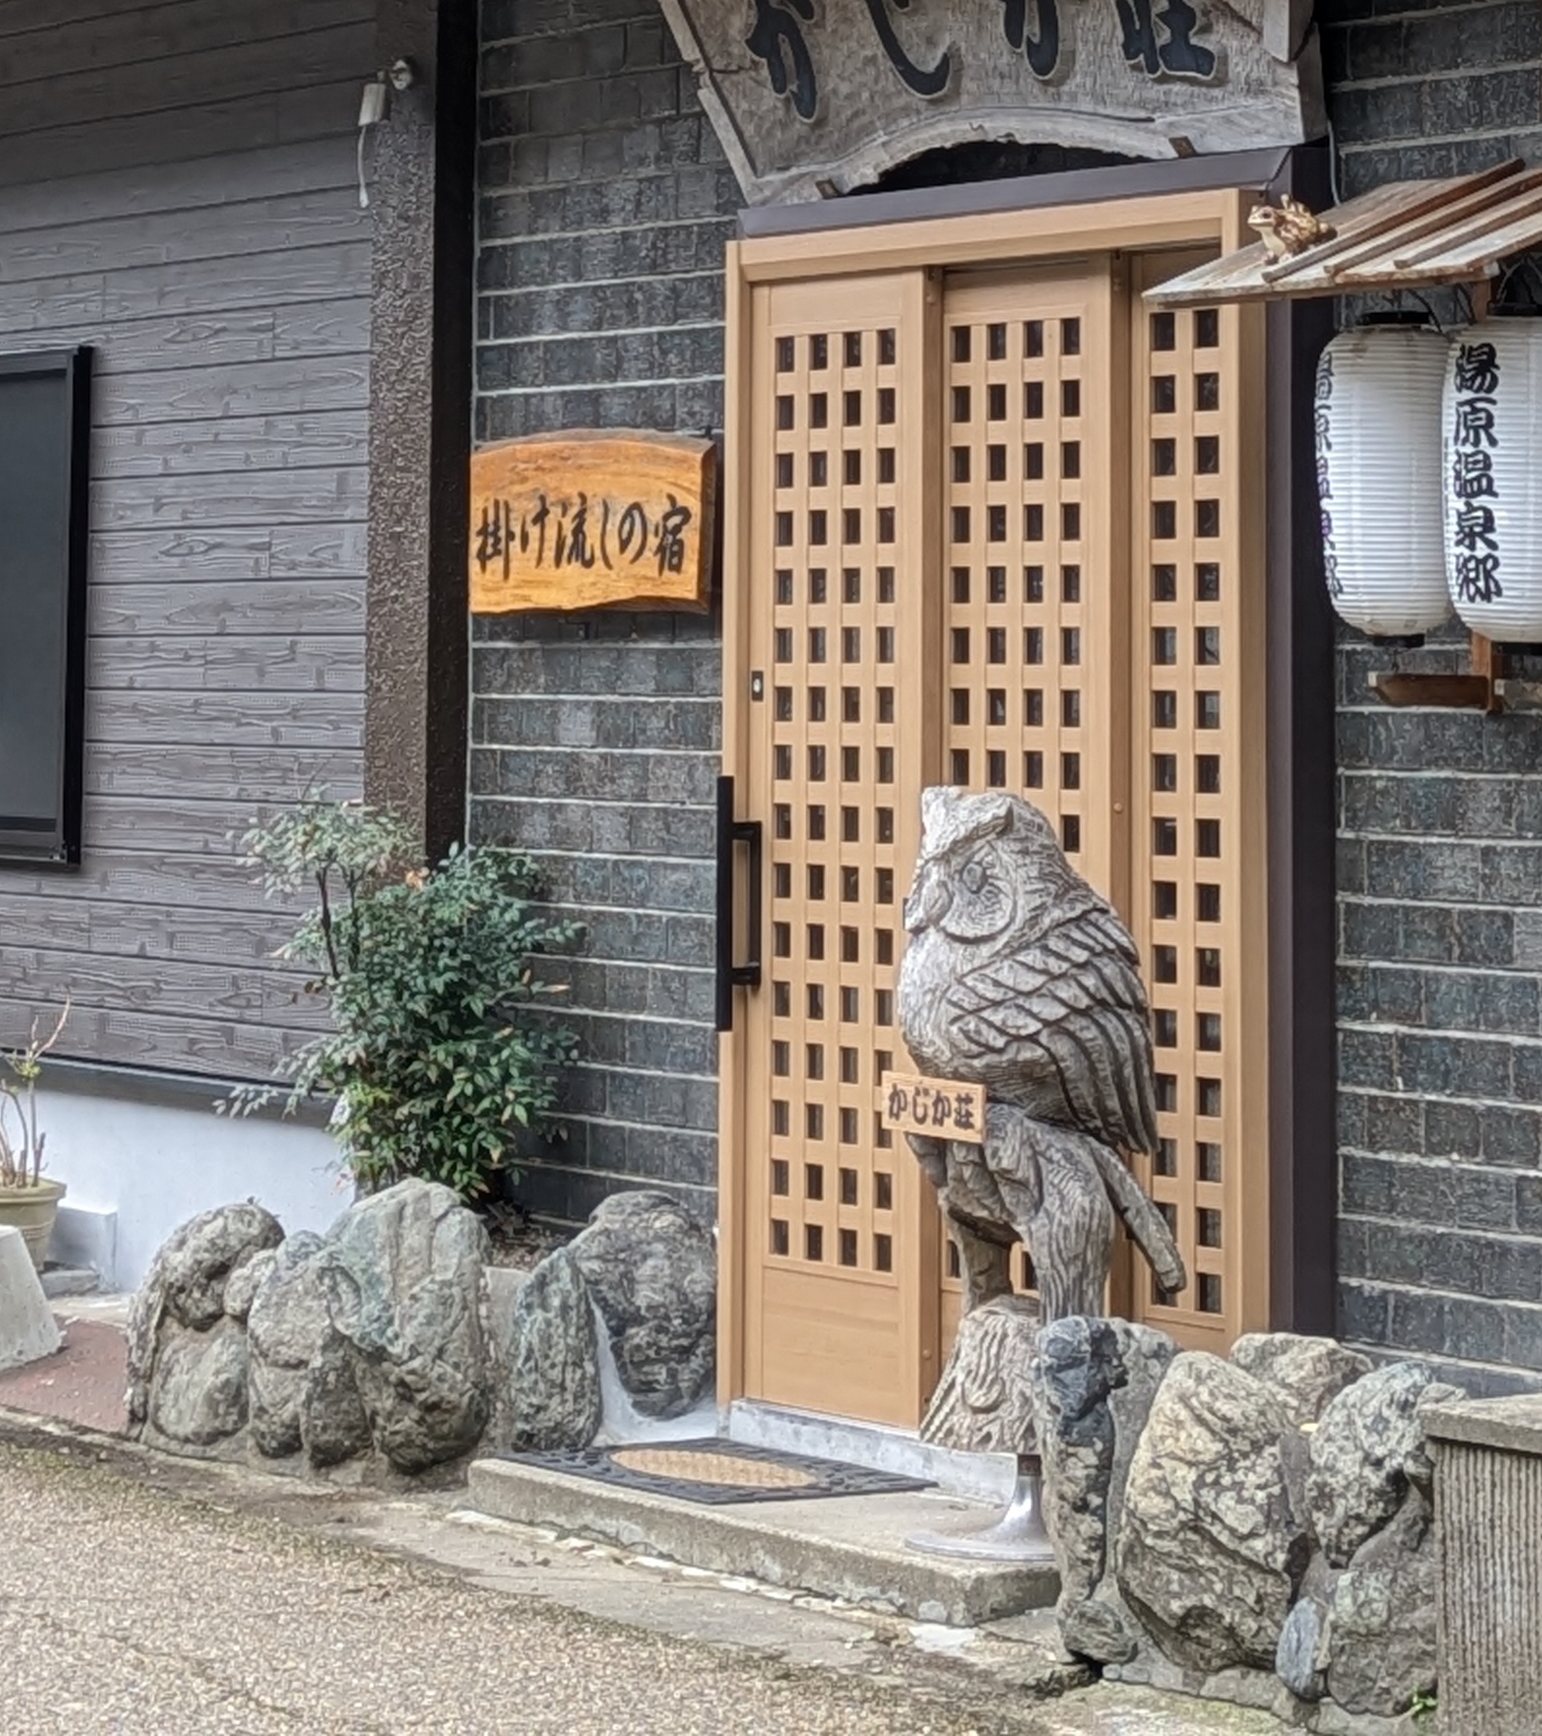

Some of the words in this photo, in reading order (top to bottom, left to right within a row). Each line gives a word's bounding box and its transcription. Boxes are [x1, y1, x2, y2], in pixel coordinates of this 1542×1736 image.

[1453, 342, 1503, 604] 湯原温泉郷
[475, 491, 693, 584] 掛け流しの宿
[888, 1082, 975, 1130] かじか荘
